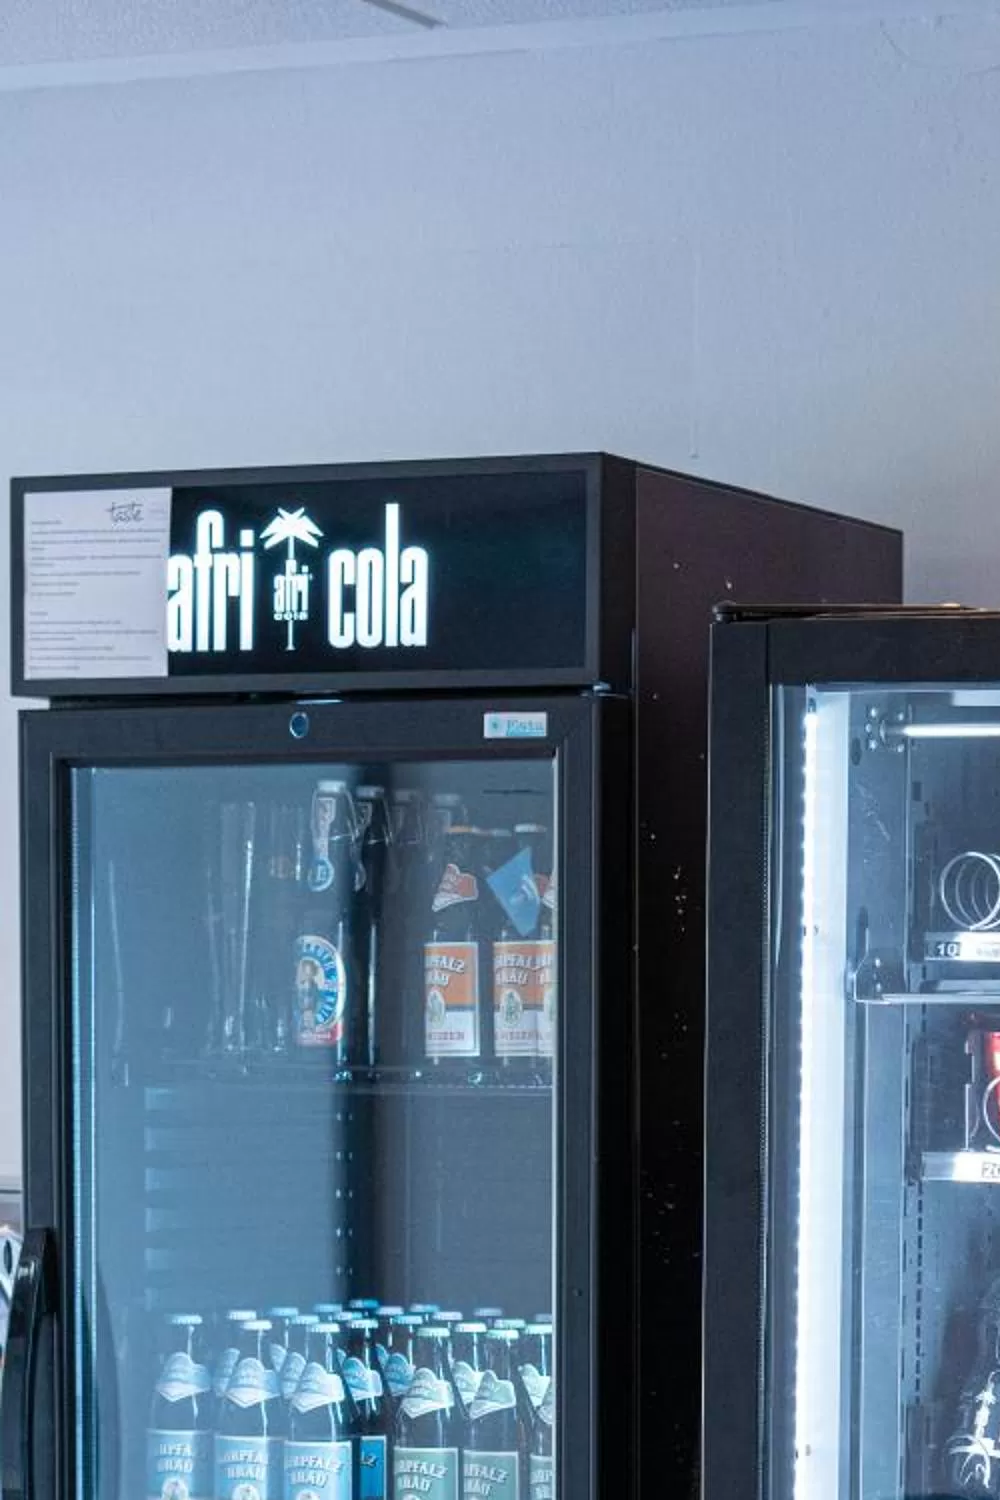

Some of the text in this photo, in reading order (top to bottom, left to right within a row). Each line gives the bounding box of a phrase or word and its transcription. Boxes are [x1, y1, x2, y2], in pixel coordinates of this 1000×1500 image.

[167, 509, 254, 652] afri
[327, 502, 429, 648] cola
[273, 559, 309, 612] afri
[935, 942, 958, 958] 10
